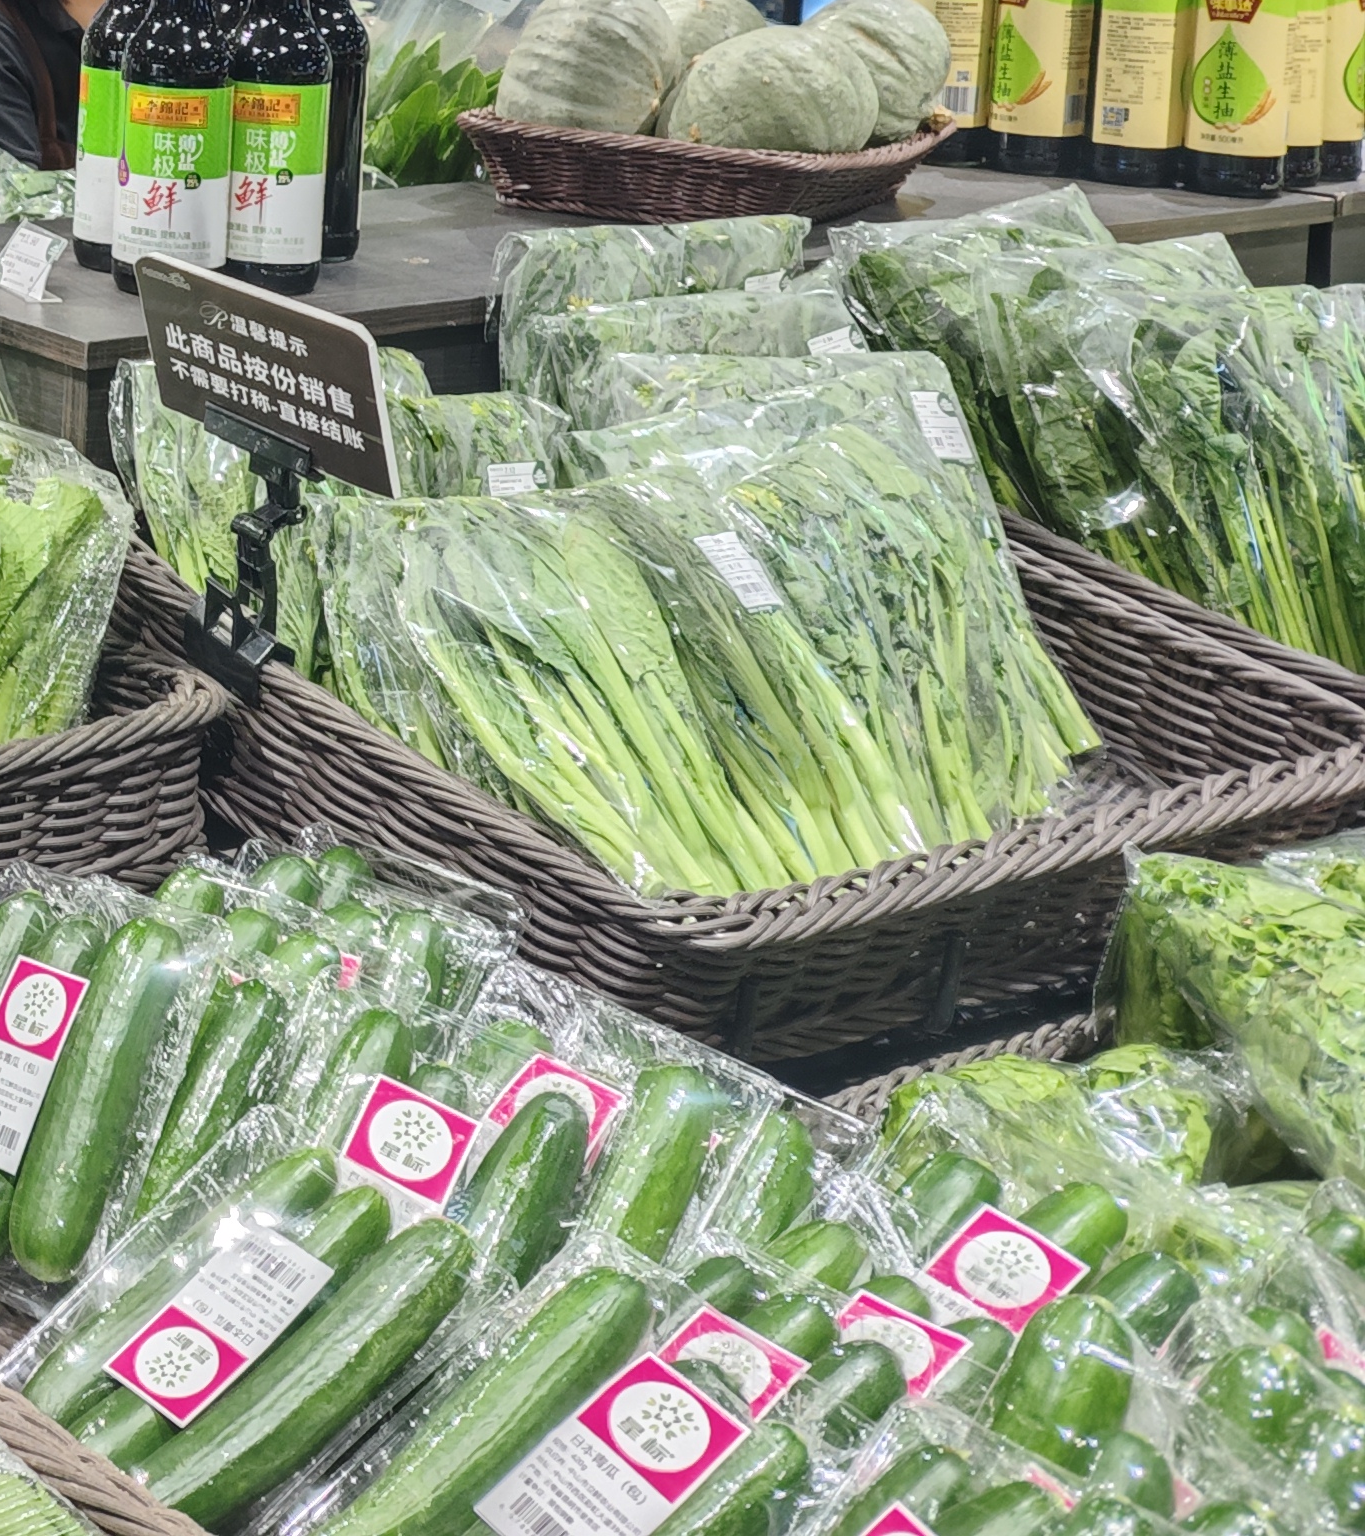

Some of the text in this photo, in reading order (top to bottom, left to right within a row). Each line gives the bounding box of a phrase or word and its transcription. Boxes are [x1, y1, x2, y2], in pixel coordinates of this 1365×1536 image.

[1213, 40, 1237, 120] 薄盐生抽
[146, 99, 189, 116] 李錦記
[238, 96, 281, 113] 李錦記
[229, 313, 309, 357] 温馨提示
[164, 322, 355, 420] 此商品按份销售
[12, 1013, 48, 1038] 星标
[379, 1140, 430, 1174] 星标
[167, 1332, 213, 1365] 星标
[617, 1415, 675, 1463] 星标
[569, 1430, 649, 1508] 日本青瓜（包）
